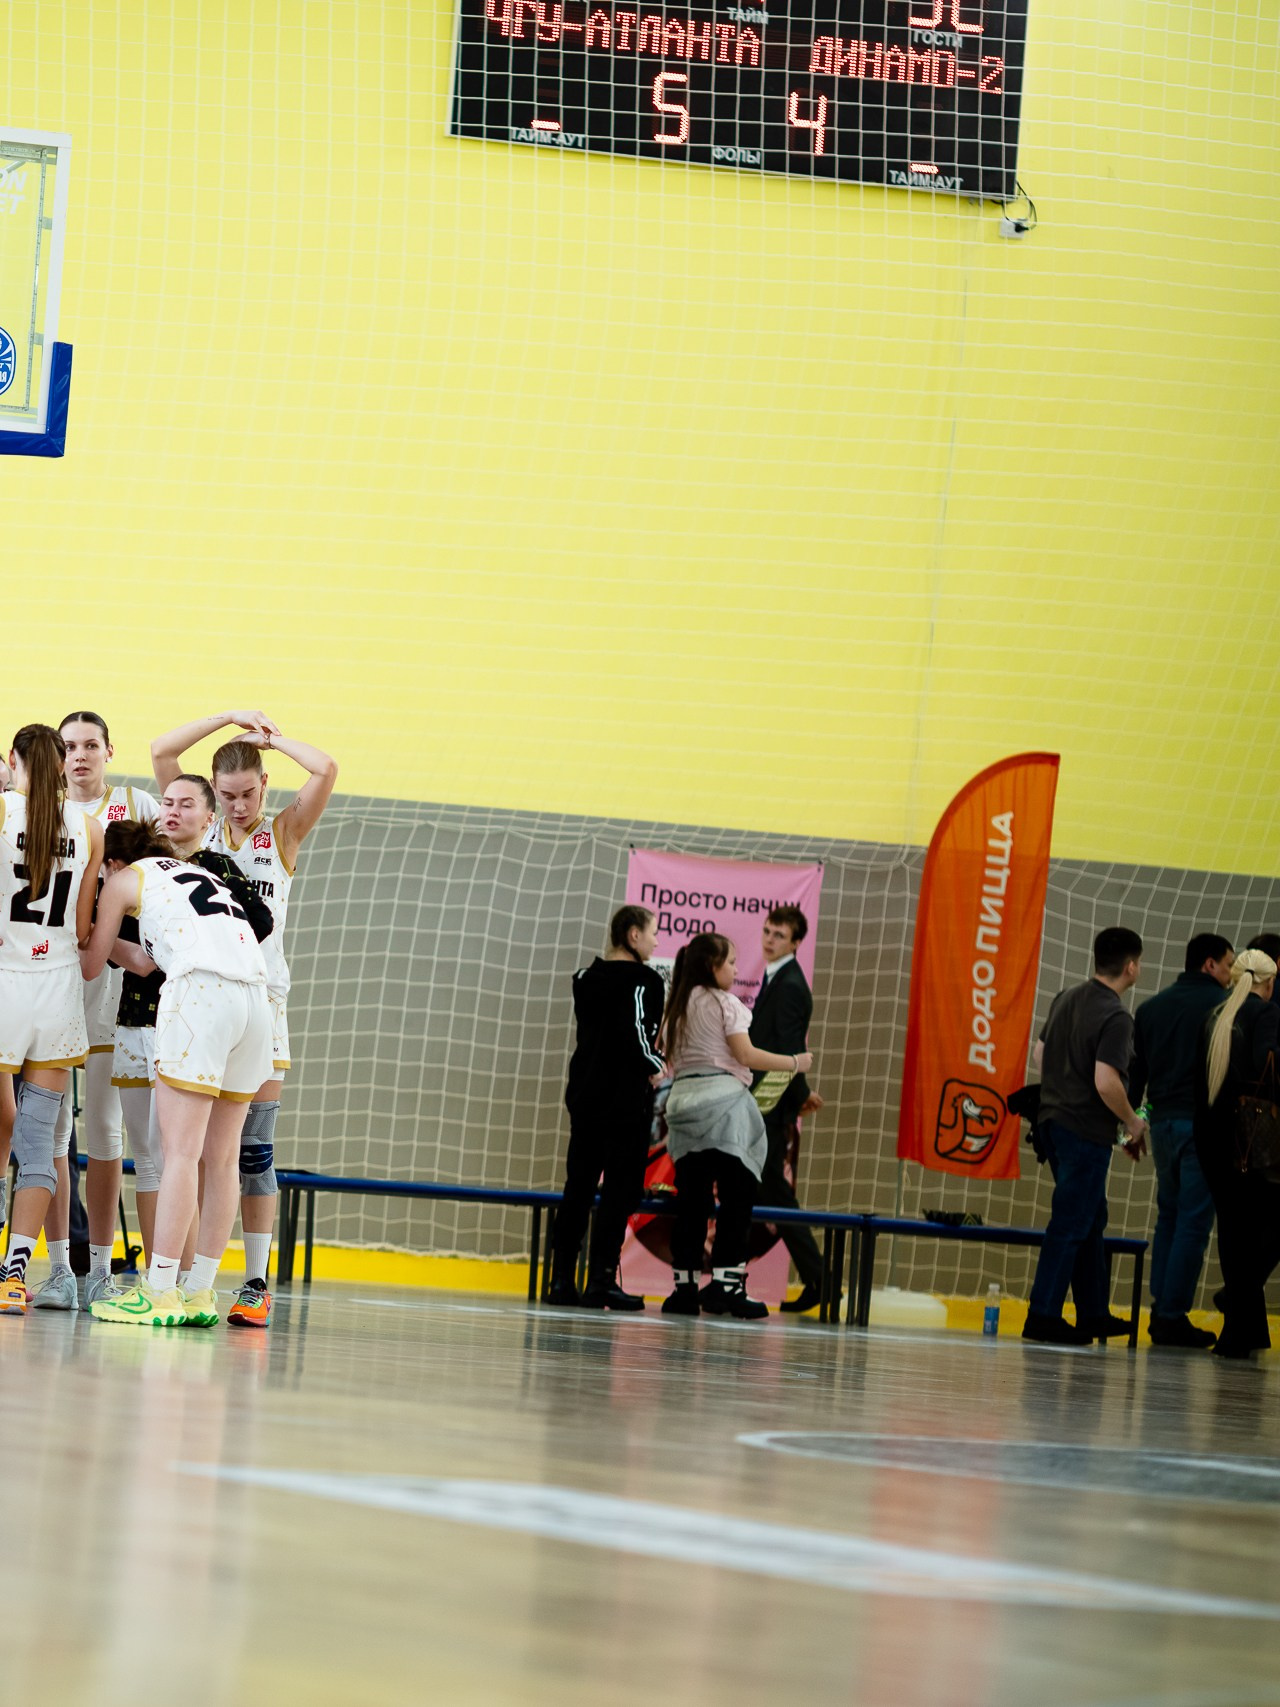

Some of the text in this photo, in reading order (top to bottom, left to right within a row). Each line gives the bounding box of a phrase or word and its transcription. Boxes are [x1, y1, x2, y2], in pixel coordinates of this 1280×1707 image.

[727, 7, 768, 25] ТАЙМ
[911, 29, 964, 48] ГОСТИ
[809, 36, 1004, 94] ДИНАМО-2
[652, 71, 690, 145] 5
[789, 91, 827, 156] 4
[510, 127, 586, 148] ТАЙМ-АУТ
[712, 146, 761, 164] ФОЛЫ
[889, 170, 964, 190] ТАЙМ-АУТ
[108, 805, 127, 813] FON
[9, 863, 73, 928] 21
[641, 883, 727, 910] Просто
[657, 911, 716, 937] Додо
[968, 811, 1014, 1073] ДОДО ПИЦЦА
